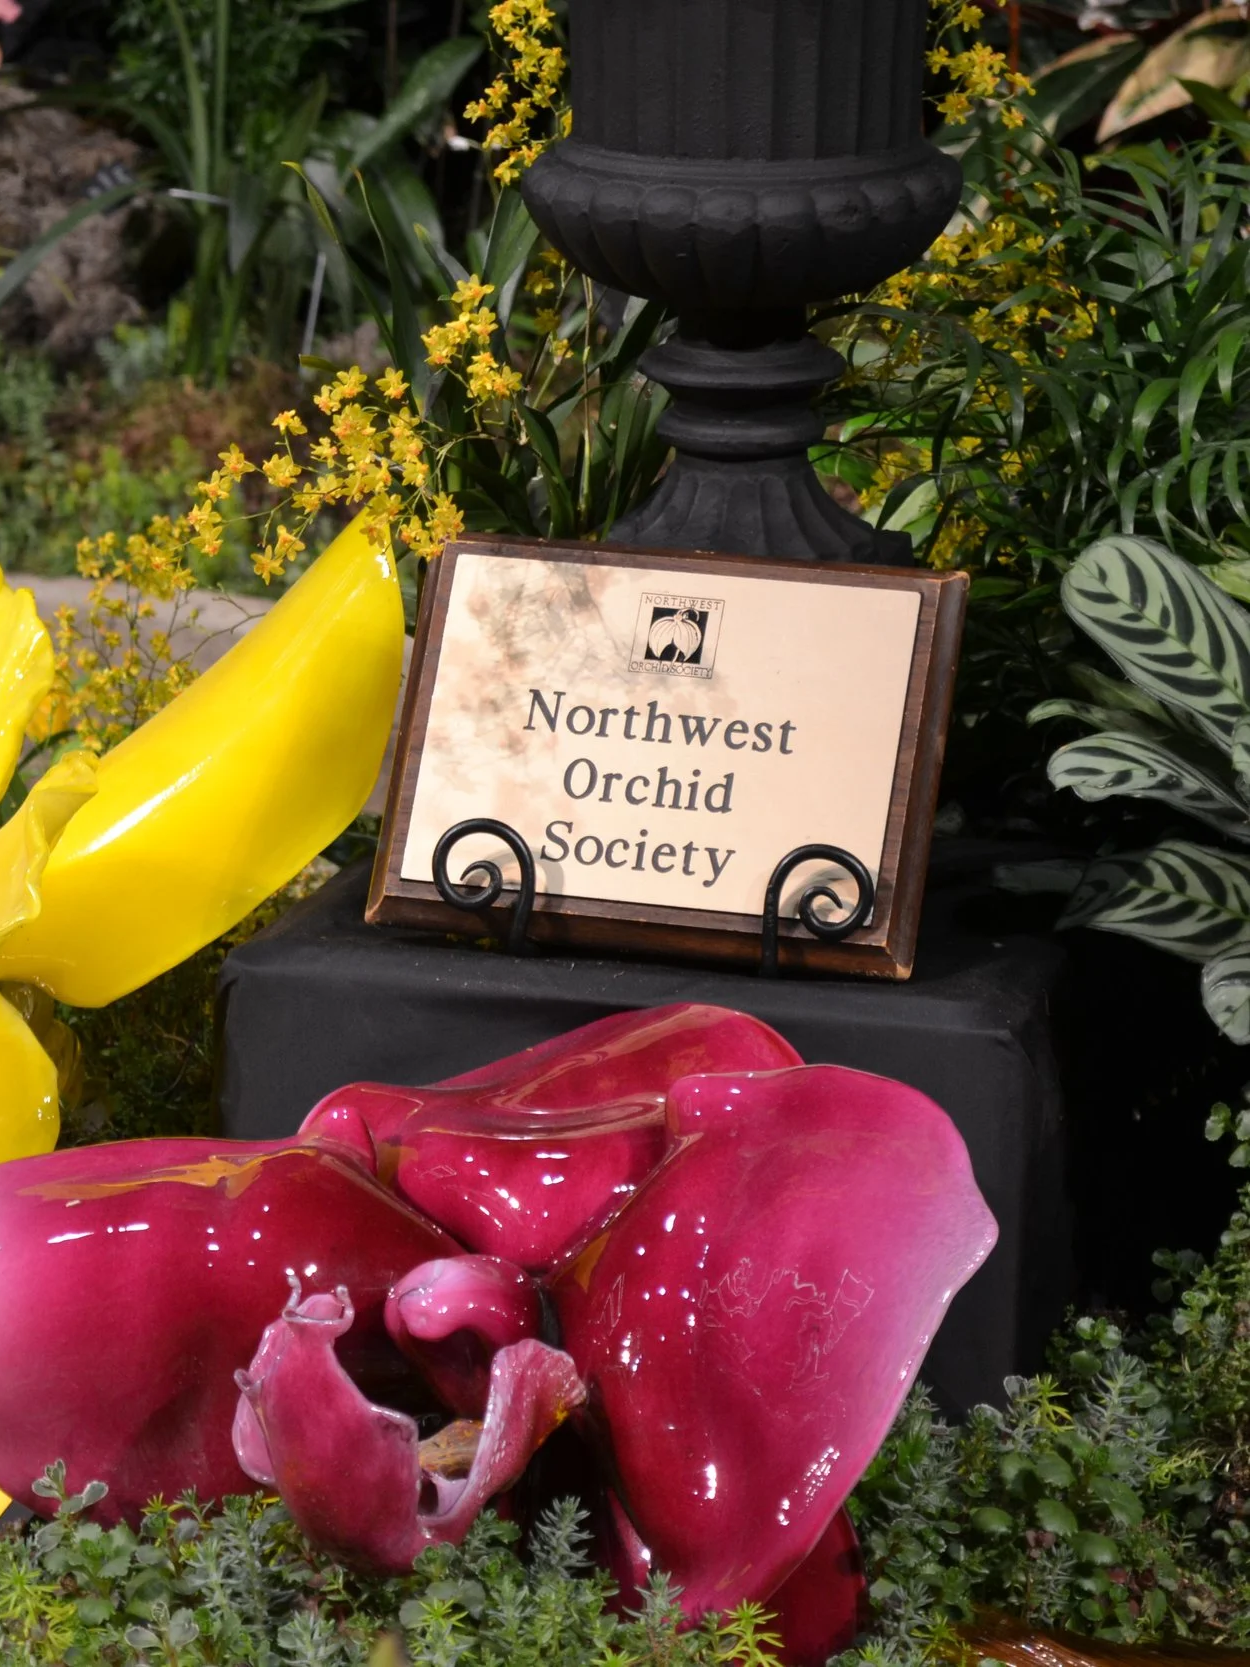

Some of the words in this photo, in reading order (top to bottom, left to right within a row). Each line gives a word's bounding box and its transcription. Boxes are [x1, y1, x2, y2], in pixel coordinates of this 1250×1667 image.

[645, 596, 722, 610] NORTHWEST
[630, 661, 669, 673] ORCHID
[670, 664, 712, 677] SOCIETY
[523, 688, 797, 755] Northwest
[563, 757, 734, 814] Orchid
[540, 820, 735, 888] Society
